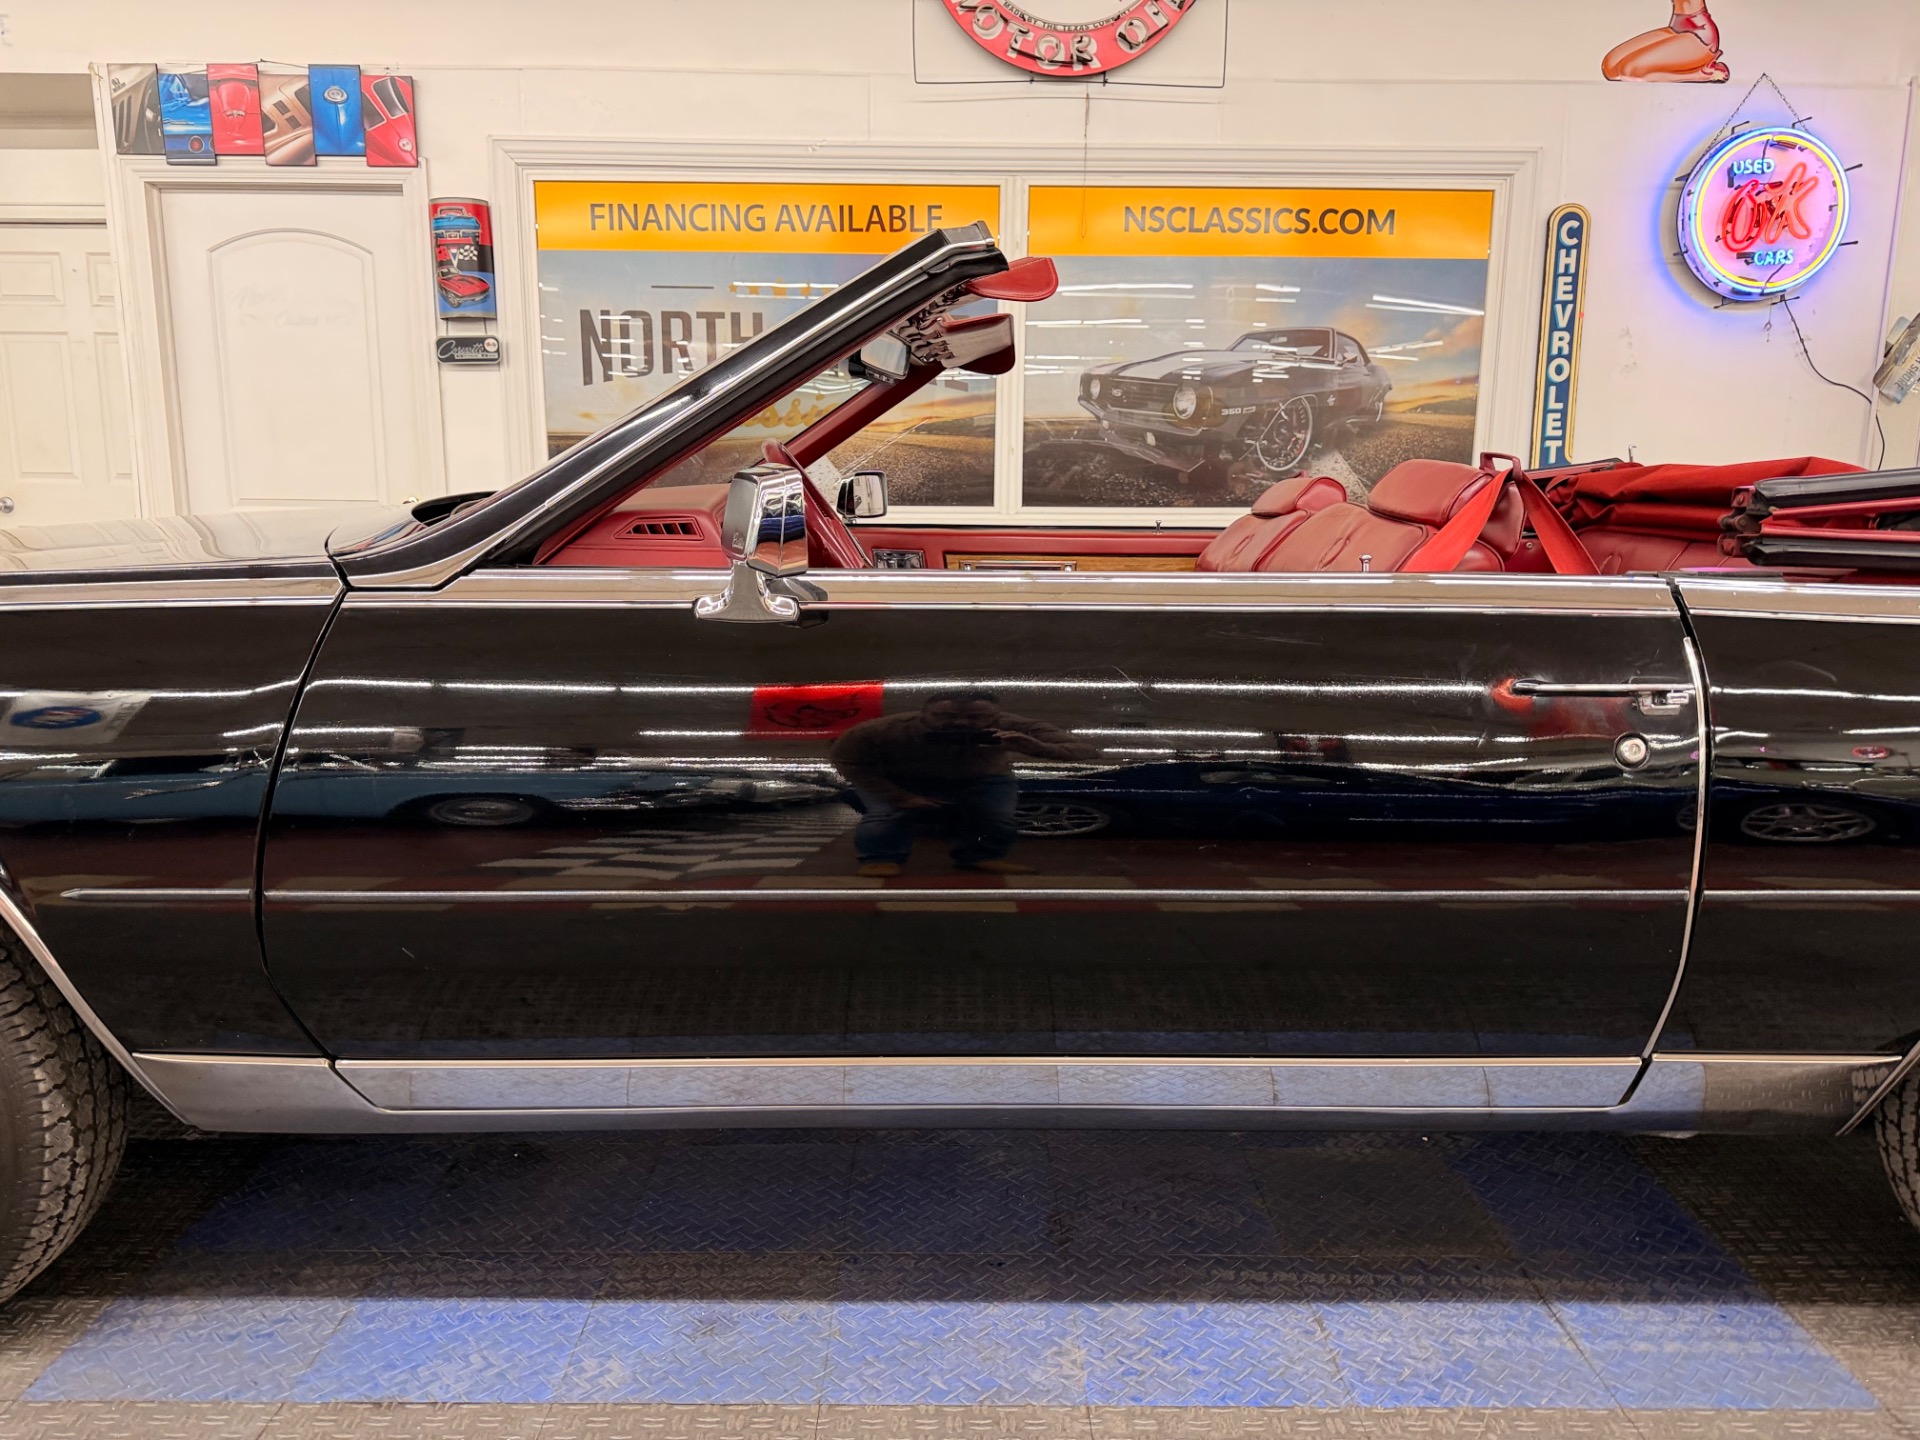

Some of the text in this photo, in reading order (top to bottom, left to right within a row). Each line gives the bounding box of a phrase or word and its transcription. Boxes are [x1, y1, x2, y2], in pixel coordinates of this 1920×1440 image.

[1027, 16, 1038, 25] BY
[1042, 21, 1059, 30] THE
[1063, 23, 1090, 31] TEXAS
[1733, 159, 1775, 175] USED
[590, 203, 943, 233] FINANCING AVAILABLE
[1124, 206, 1396, 235] NSCLASSICS.COM
[1721, 162, 1820, 253] OK
[1754, 249, 1794, 266] CARS
[579, 309, 764, 387] NORTH
[1544, 220, 1581, 465] CHEVROLET
